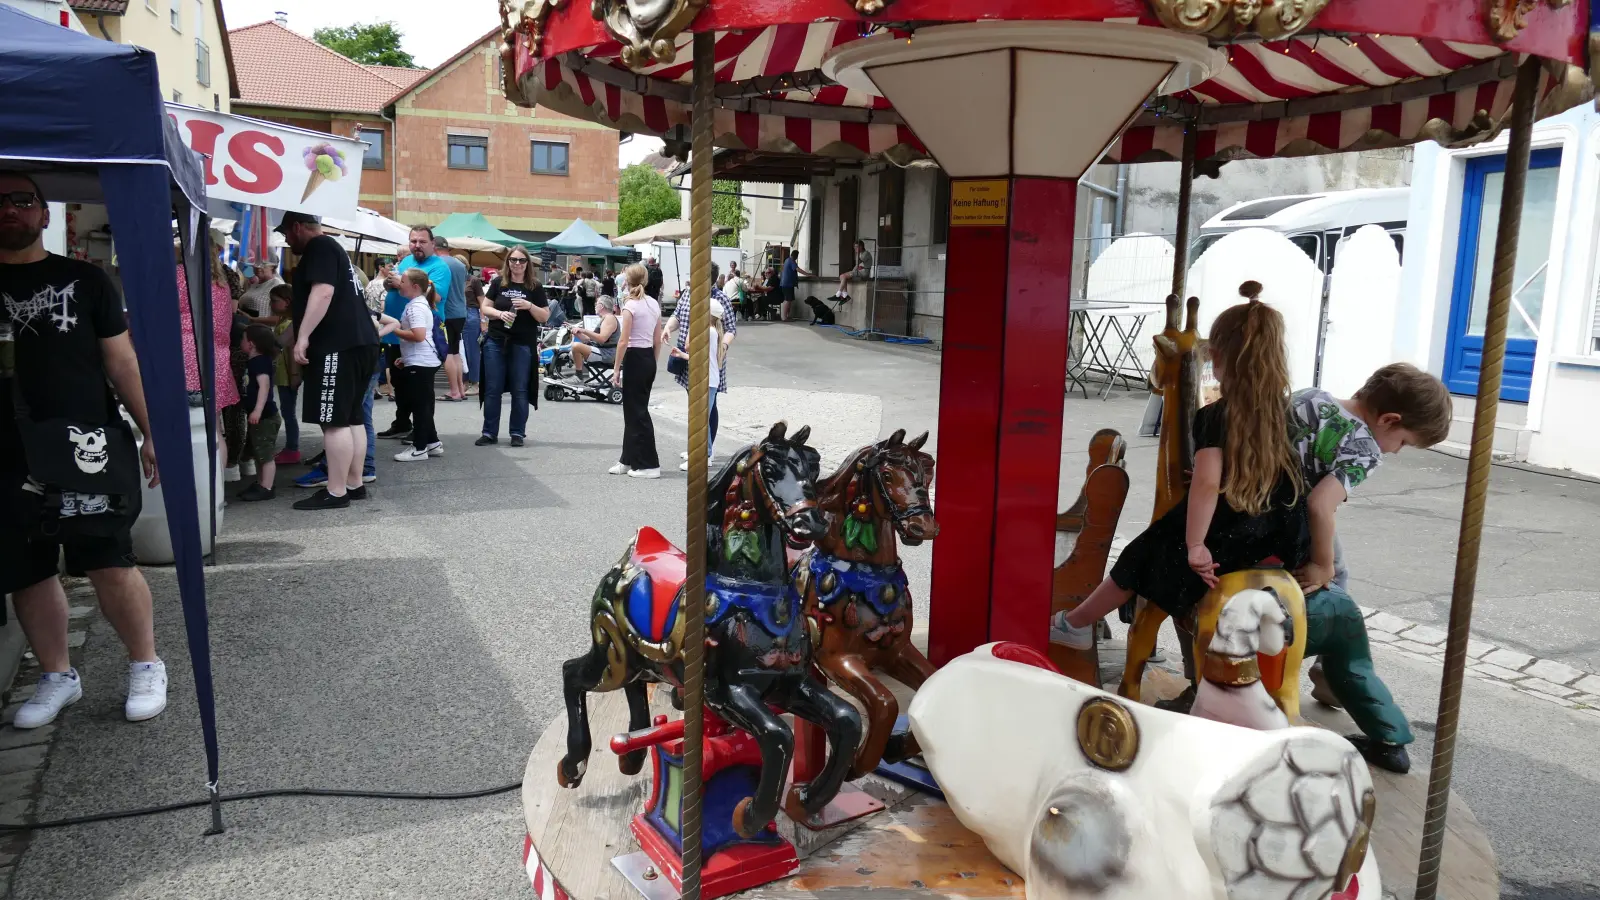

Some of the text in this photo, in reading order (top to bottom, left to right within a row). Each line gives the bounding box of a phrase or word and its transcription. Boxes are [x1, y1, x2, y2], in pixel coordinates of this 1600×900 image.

[167, 113, 286, 194] IS
[953, 198, 972, 207] Keine
[973, 198, 999, 208] Haftung
[326, 403, 334, 423] ROAD
